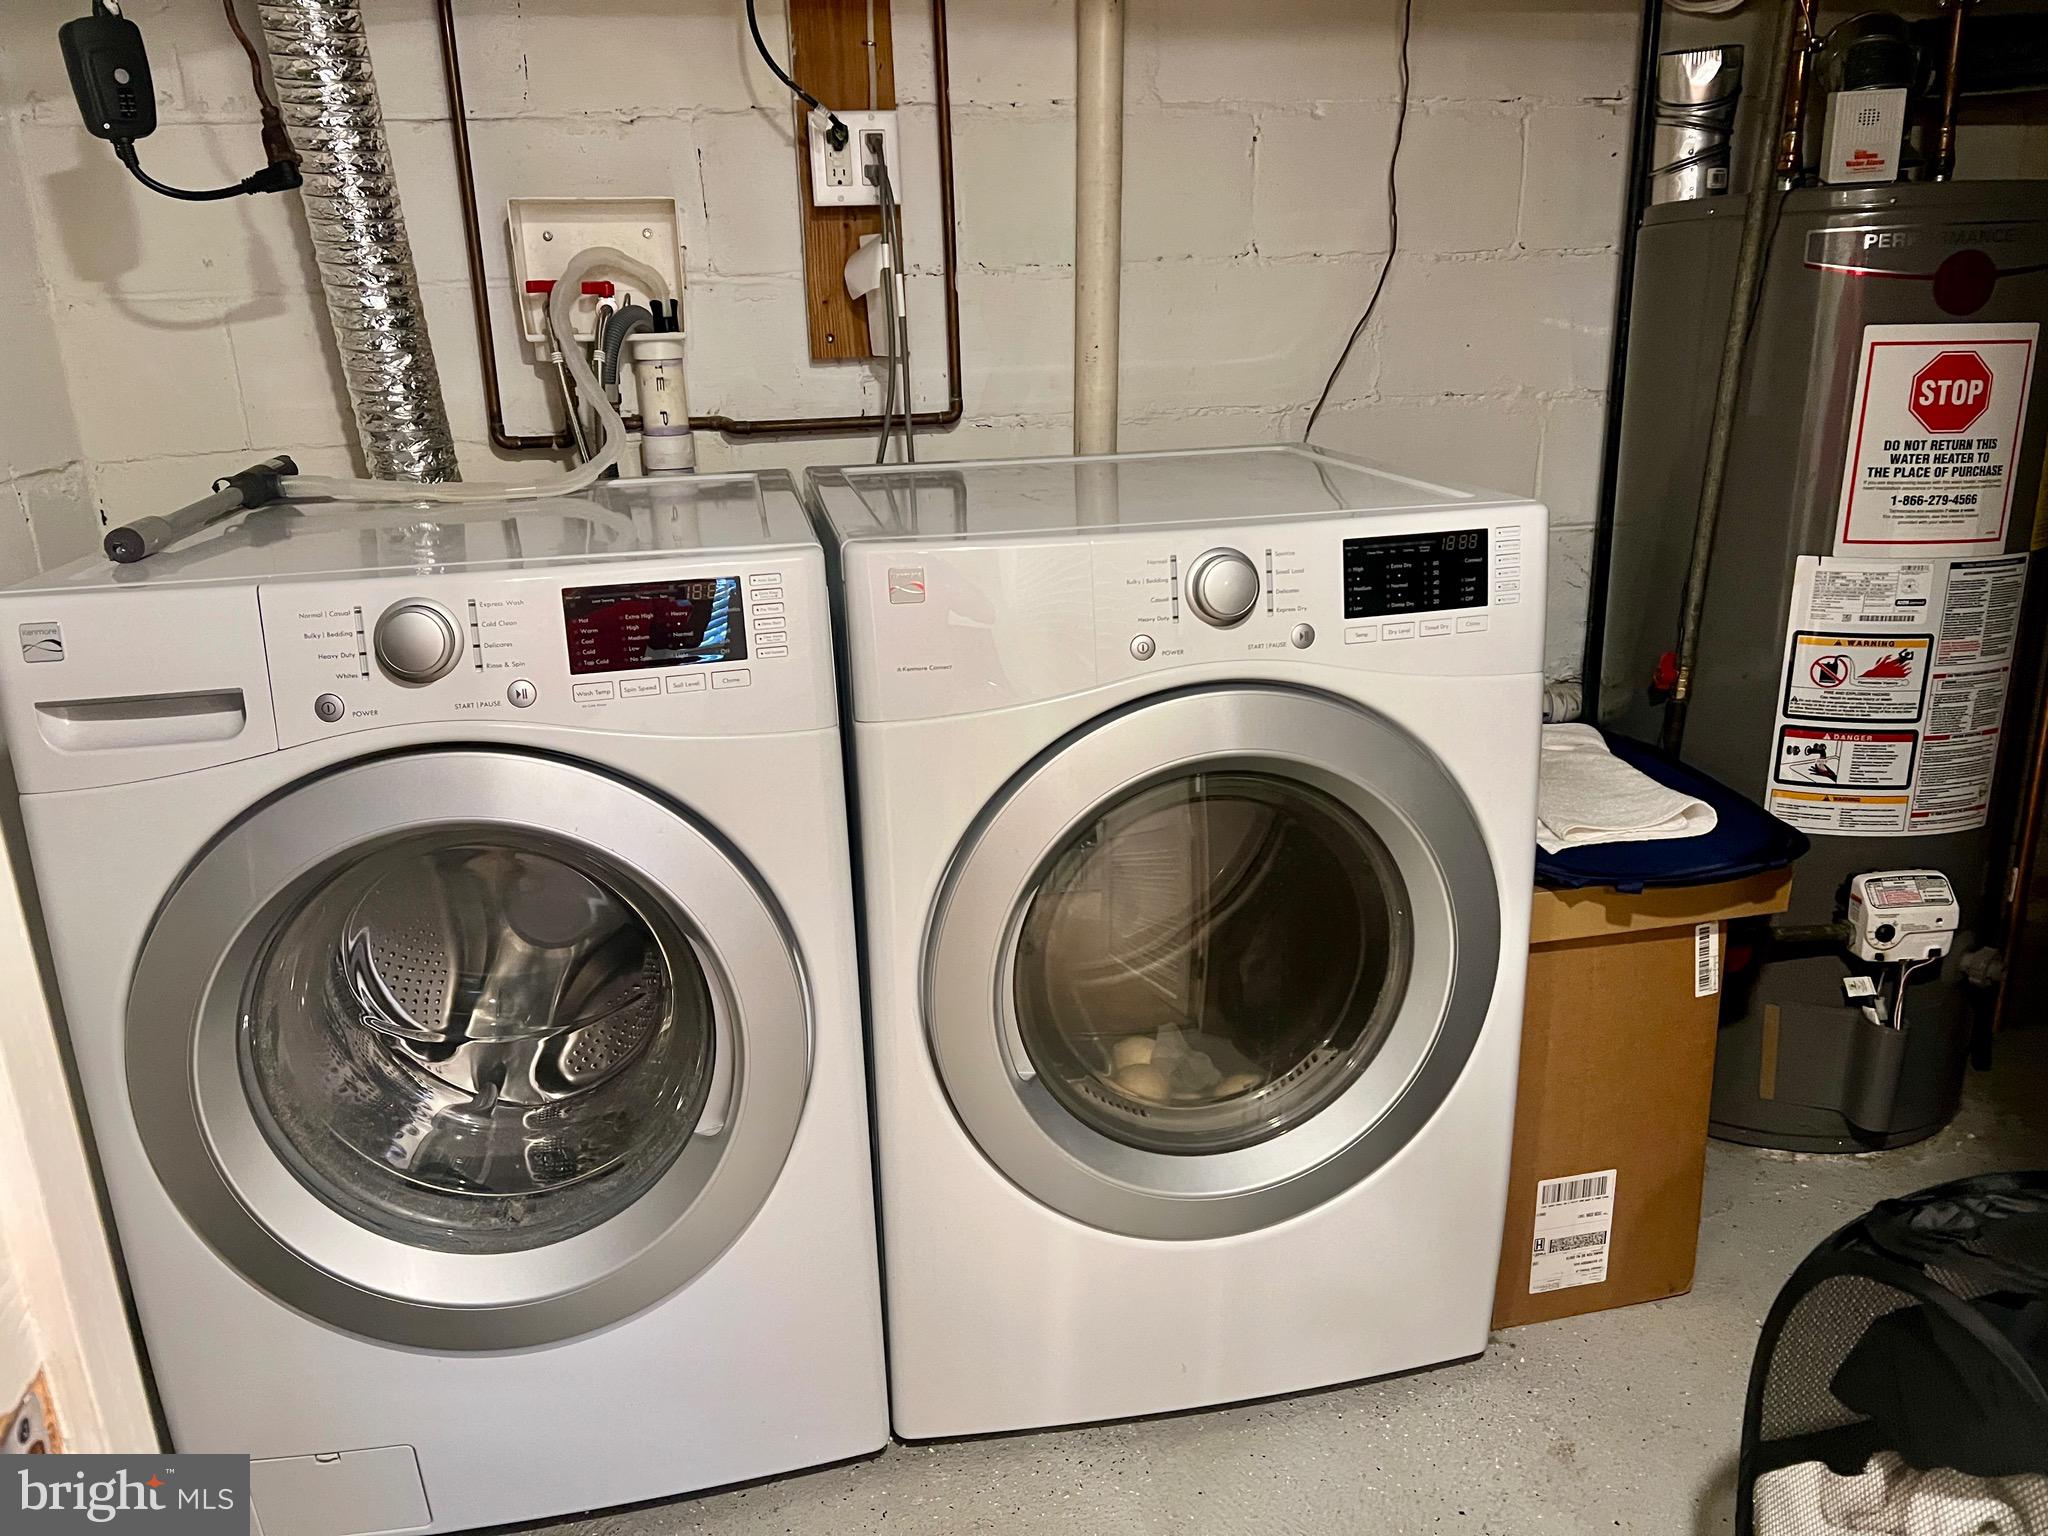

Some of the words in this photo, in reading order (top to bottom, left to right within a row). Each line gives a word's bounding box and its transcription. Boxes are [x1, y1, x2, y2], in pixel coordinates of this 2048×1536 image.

[1918, 379, 1984, 406] STOP
[1884, 440, 1900, 451] DO
[1904, 440, 1927, 451] NOT
[1930, 440, 1973, 451] RETURN
[1976, 438, 1998, 450] THIS
[1890, 454, 1930, 464] WATER
[1933, 453, 1974, 464] HEATER
[1977, 452, 1990, 463] TO
[1867, 467, 1890, 478] THE
[1894, 467, 1930, 478] PLACE
[1934, 466, 1949, 478] OF
[1952, 465, 2003, 477] PURCHASE
[1890, 494, 1978, 506] 1-866-279-4566
[479, 600, 504, 610] Express
[298, 611, 324, 619] Normal
[329, 610, 351, 618] Casual
[482, 620, 498, 628] Cold
[304, 632, 321, 640] Bulky
[326, 630, 353, 639] Bedding
[484, 641, 513, 649] Delicates
[1847, 640, 1895, 648] WARNING
[318, 653, 338, 661] Heavy
[340, 652, 356, 660] Duty
[336, 672, 359, 680] Whites
[686, 680, 700, 688] Level
[595, 688, 611, 697] Temp
[624, 686, 637, 694] Spin
[638, 684, 657, 693] Speed
[454, 702, 475, 710] START
[480, 700, 501, 708] PAUSE
[352, 710, 378, 718] POWER
[1833, 734, 1873, 742] DANGER
